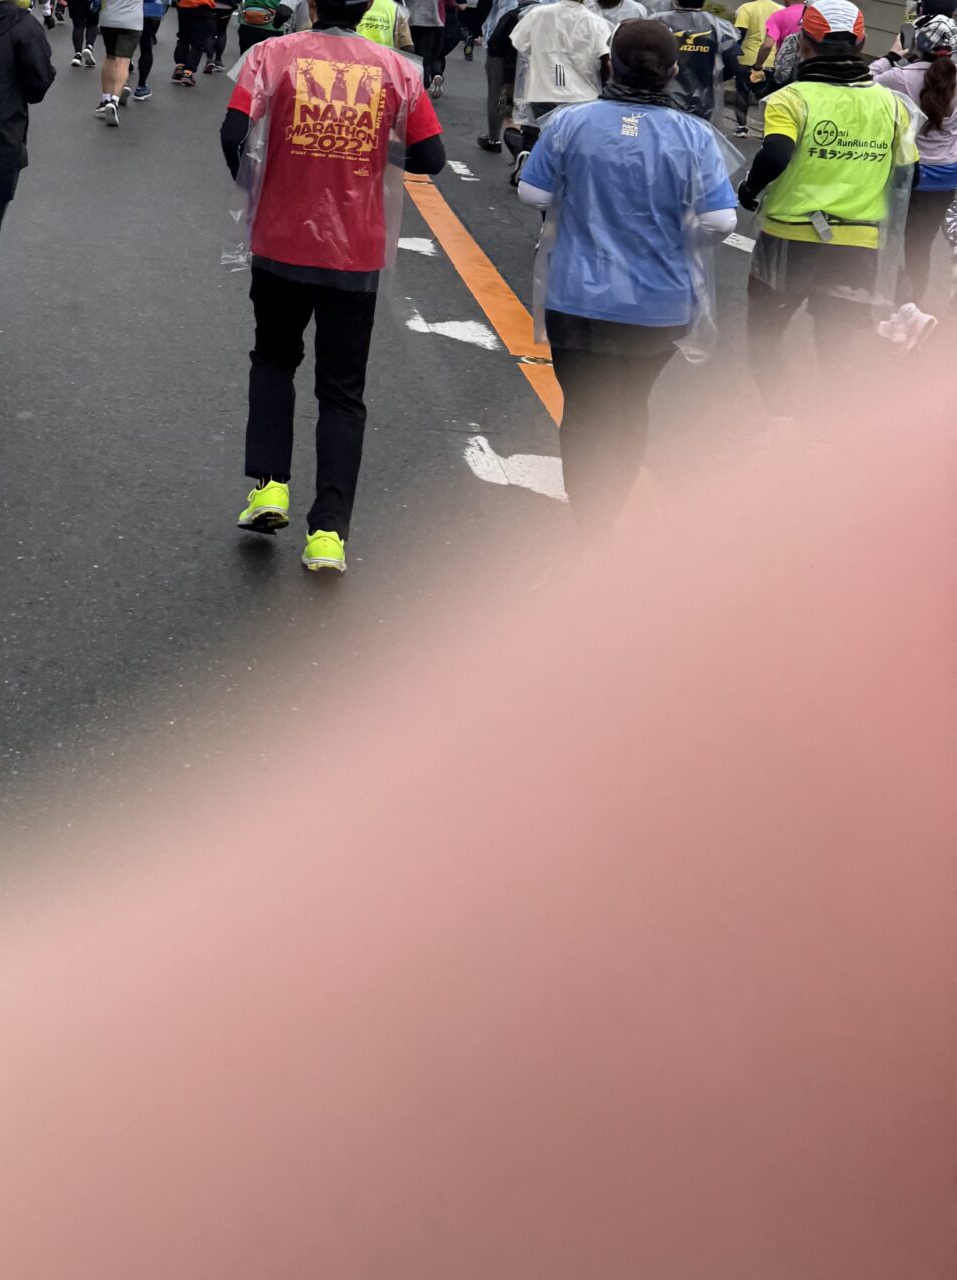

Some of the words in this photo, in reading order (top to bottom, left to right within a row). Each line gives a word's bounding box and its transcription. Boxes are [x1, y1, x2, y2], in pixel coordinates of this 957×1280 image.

[300, 104, 373, 129] NARA
[287, 122, 377, 148] MARATHON
[304, 134, 363, 154] 2022
[837, 138, 868, 148] RunRun
[870, 140, 888, 149] Club
[807, 148, 886, 163] 千里ランランクラブ
